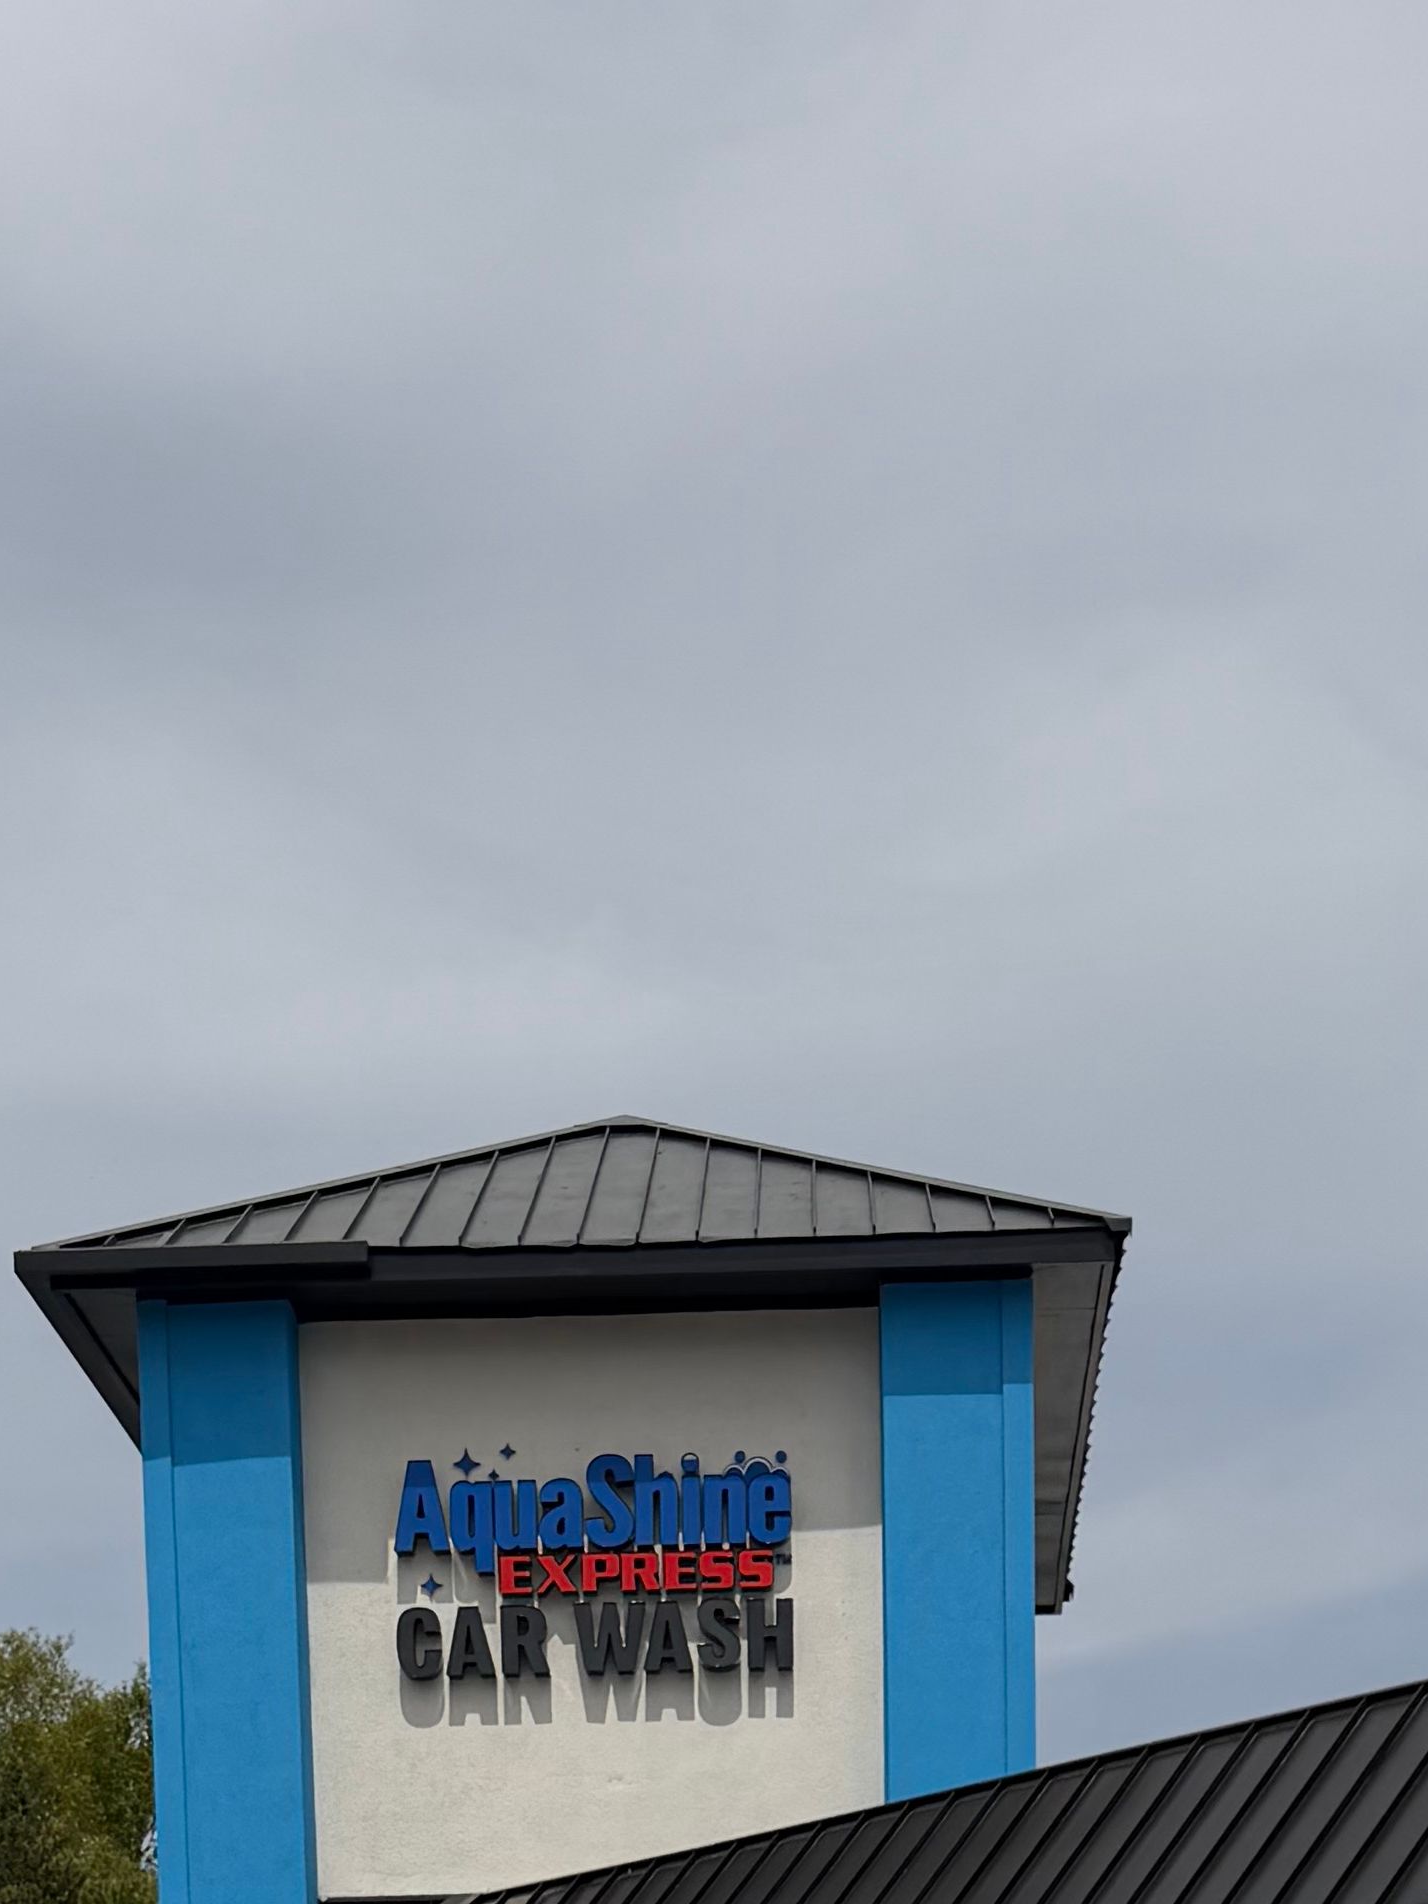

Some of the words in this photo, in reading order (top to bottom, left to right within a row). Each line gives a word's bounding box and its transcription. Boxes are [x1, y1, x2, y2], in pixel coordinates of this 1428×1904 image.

[394, 1452, 793, 1576] AquaShine
[498, 1548, 776, 1597] EXPRESS
[396, 1604, 552, 1681] CAR
[573, 1597, 795, 1677] WASH
